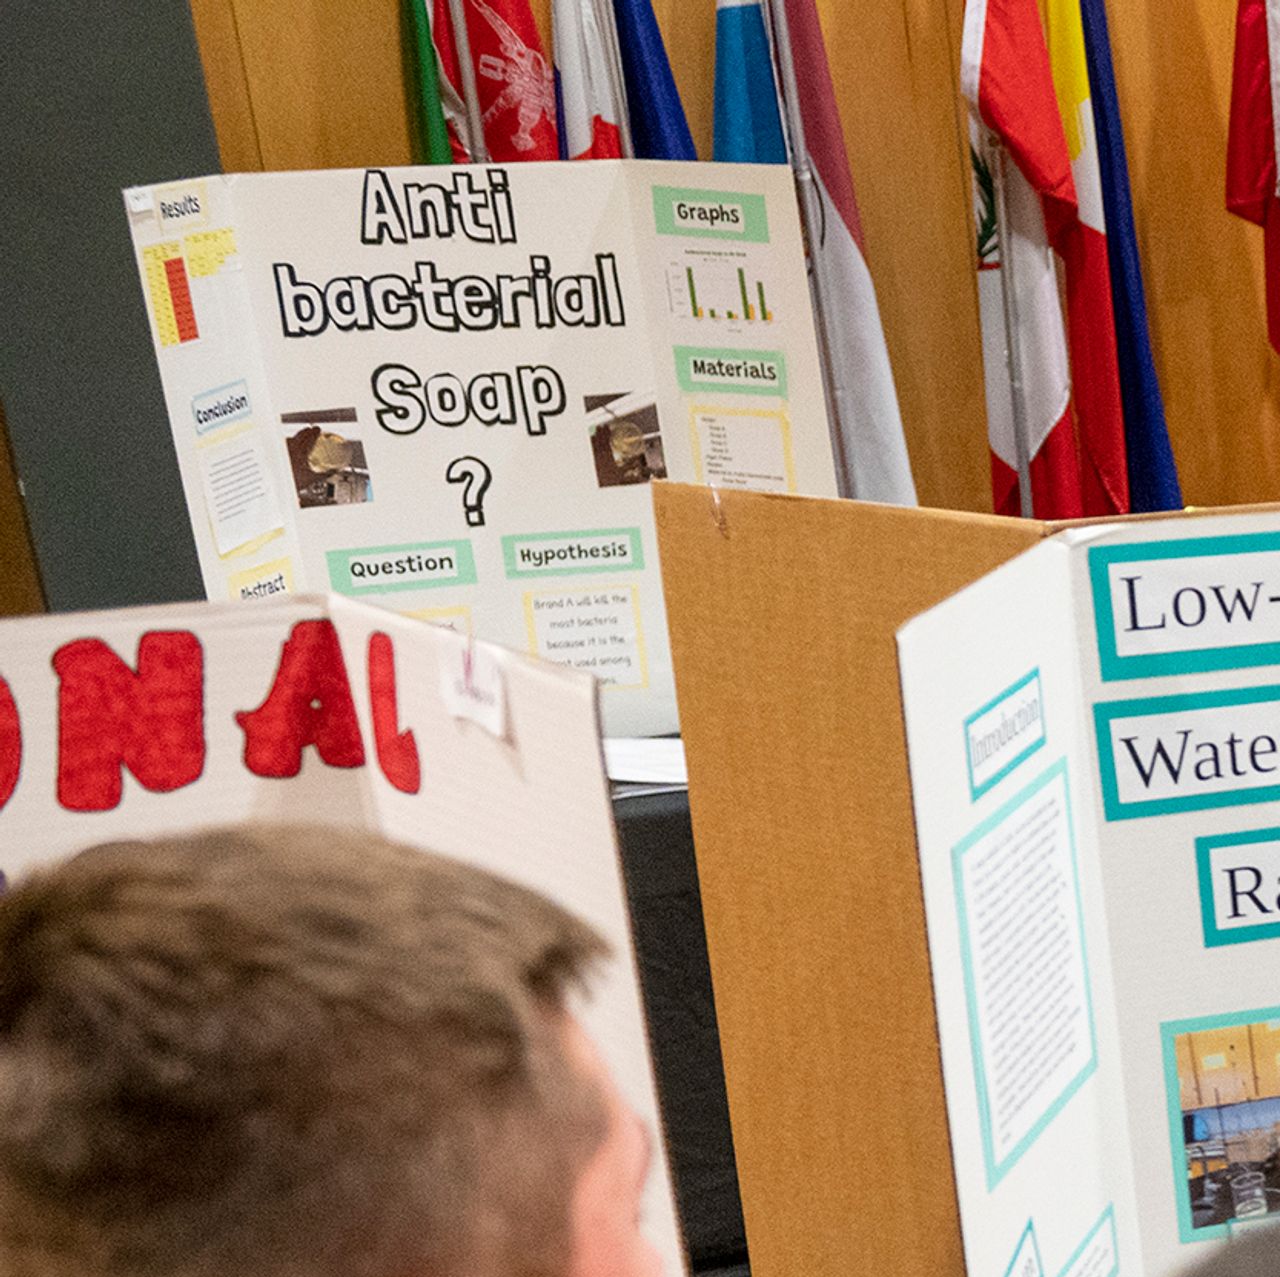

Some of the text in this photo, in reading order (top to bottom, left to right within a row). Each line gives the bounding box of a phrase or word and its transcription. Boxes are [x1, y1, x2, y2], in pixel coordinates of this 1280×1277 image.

[159, 194, 201, 220] Results
[361, 169, 517, 245] Anti
[676, 202, 740, 226] Graphs
[273, 253, 625, 338] bacterial
[692, 359, 777, 381] Materials
[196, 395, 248, 425] Conclusion
[371, 363, 566, 436] Soap
[446, 455, 492, 527] ?
[350, 555, 454, 578] Question
[520, 542, 628, 567] Hypothesis
[577, 614, 618, 628] bacteria
